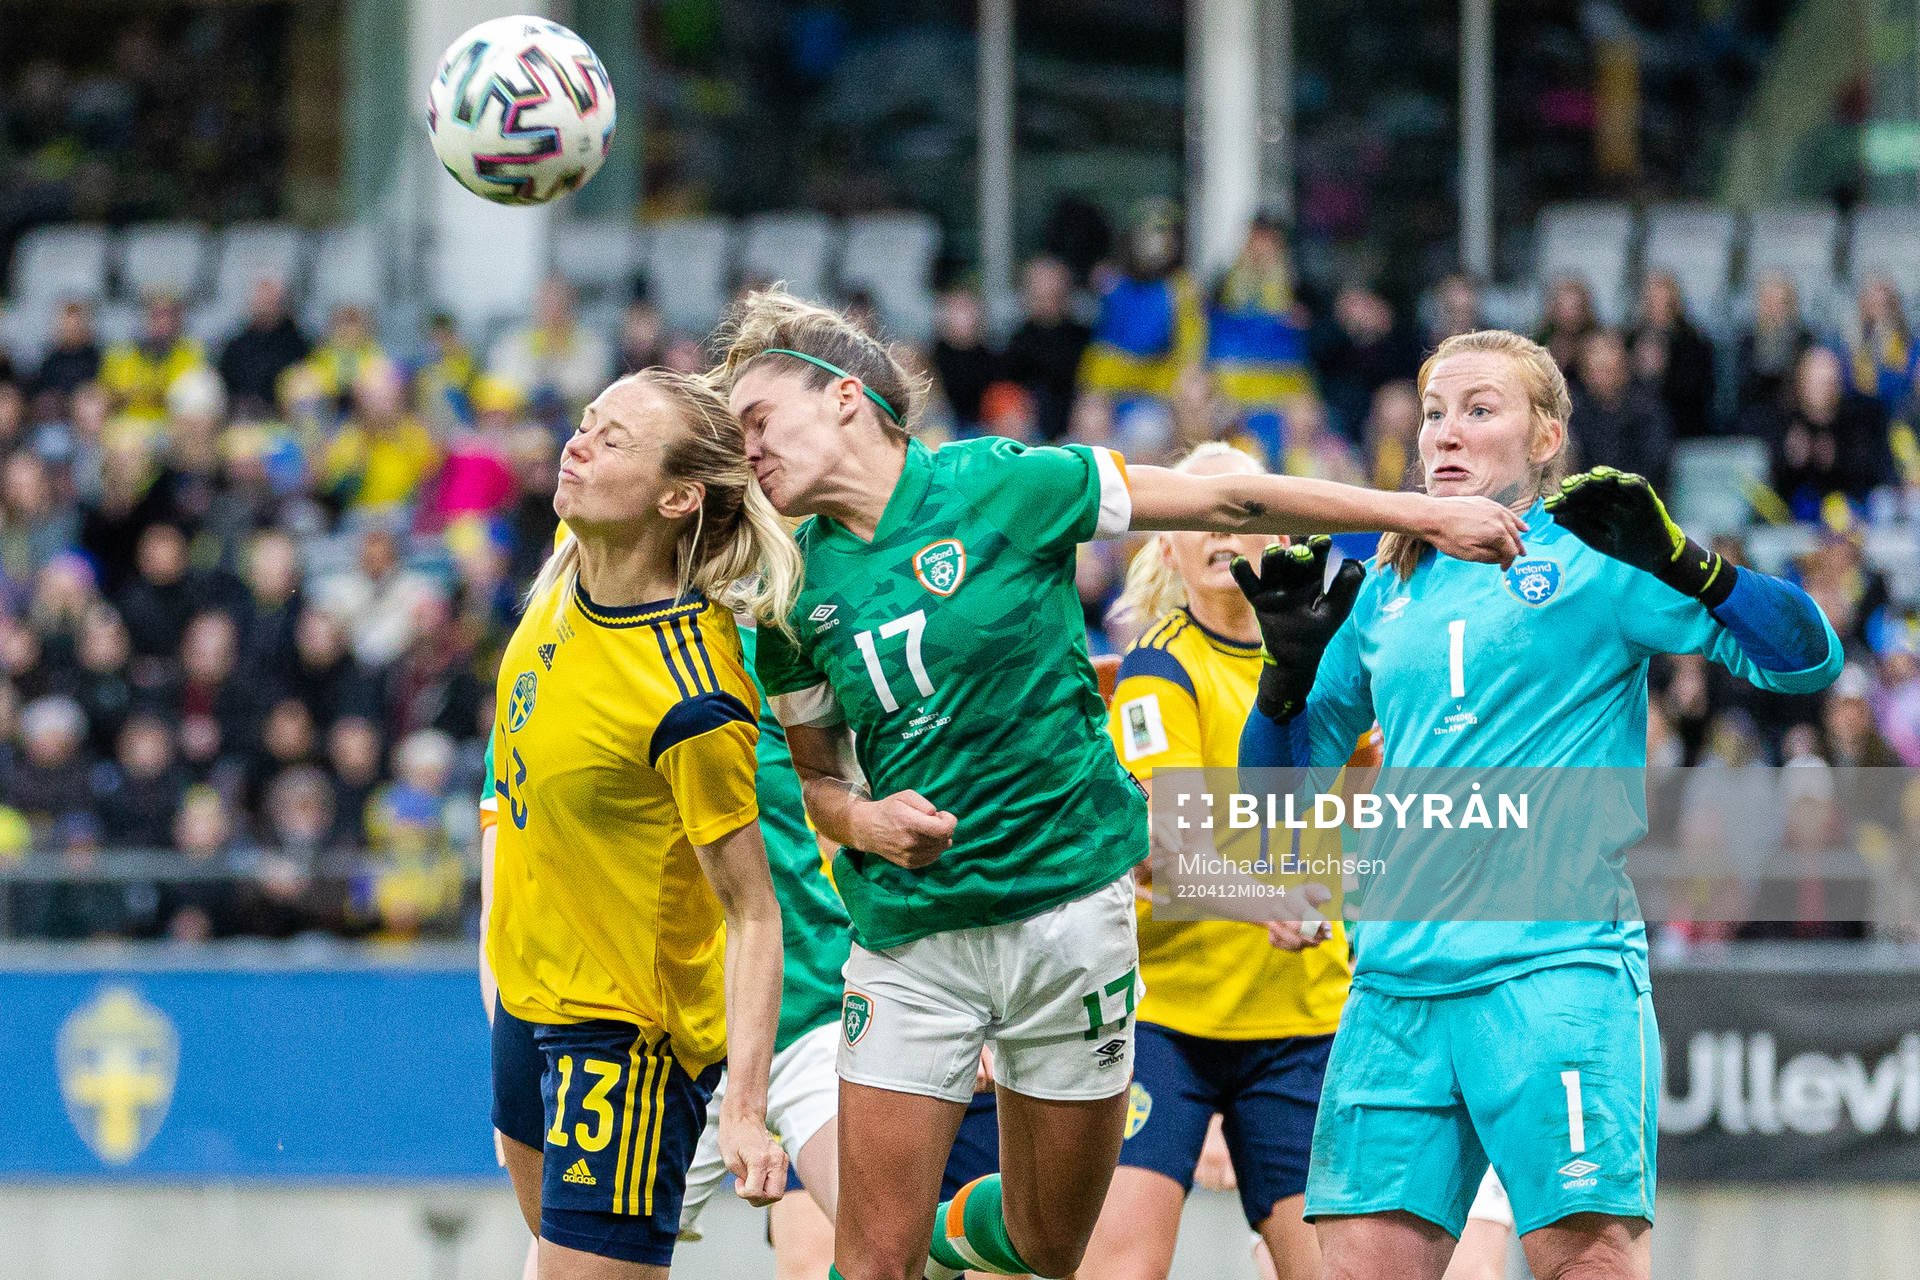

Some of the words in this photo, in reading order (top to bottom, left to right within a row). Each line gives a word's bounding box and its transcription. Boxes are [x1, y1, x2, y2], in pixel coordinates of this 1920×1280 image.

[922, 546, 954, 565] Ireland
[1514, 563, 1552, 576] Ireland
[814, 618, 840, 635] umbro
[853, 609, 936, 713] 17
[1448, 619, 1466, 698] 1
[1083, 966, 1136, 1041] 17
[1099, 1053, 1124, 1067] umbro
[547, 1055, 622, 1152] 13
[1560, 1070, 1586, 1153] 1
[562, 1173, 597, 1186] adidas
[1562, 1177, 1598, 1190] umbro
